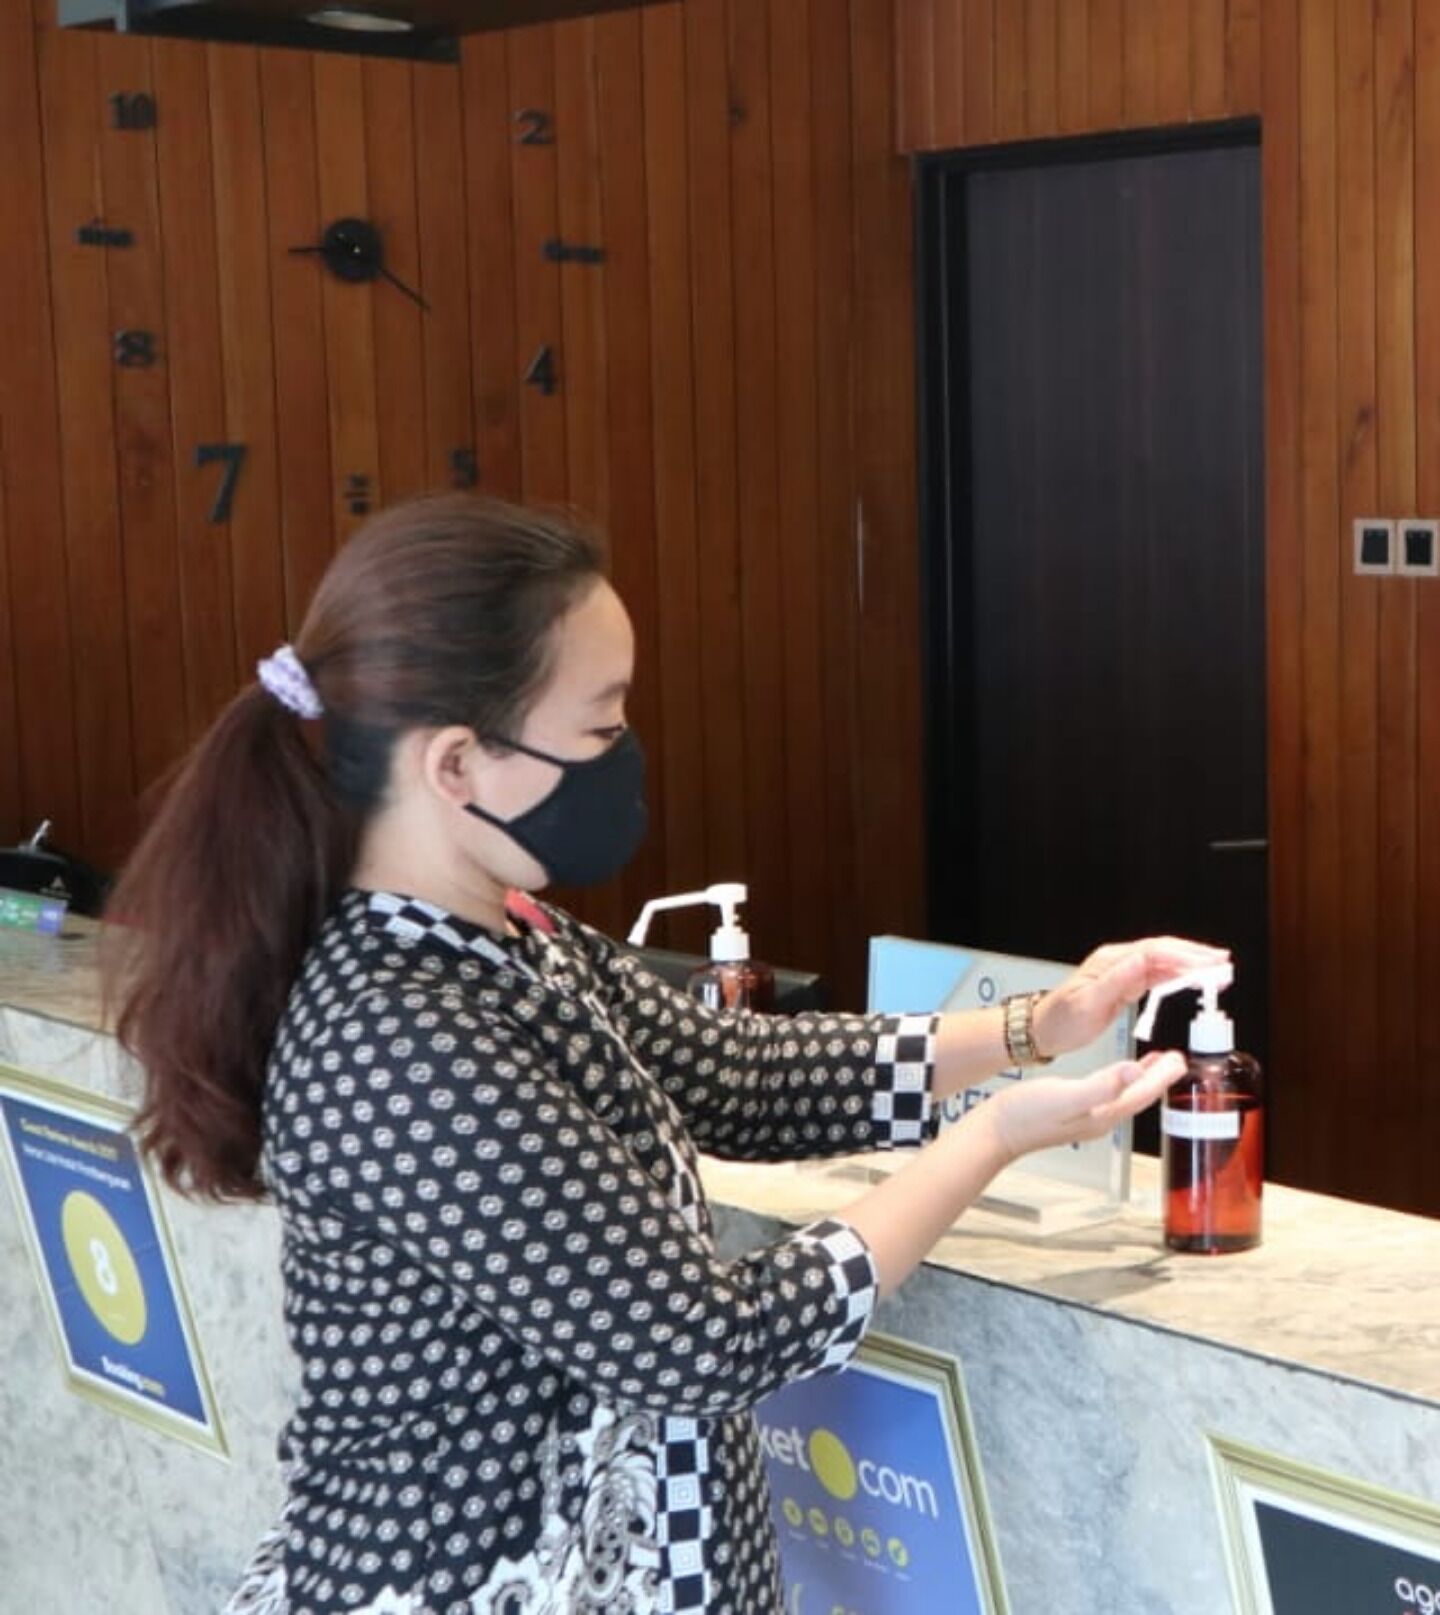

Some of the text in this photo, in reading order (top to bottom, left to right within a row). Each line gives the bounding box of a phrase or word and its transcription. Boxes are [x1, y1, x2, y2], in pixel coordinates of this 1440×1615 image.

[516, 111, 555, 144] 2
[115, 331, 157, 367] 8
[524, 346, 556, 396] 4
[194, 446, 249, 522] 7
